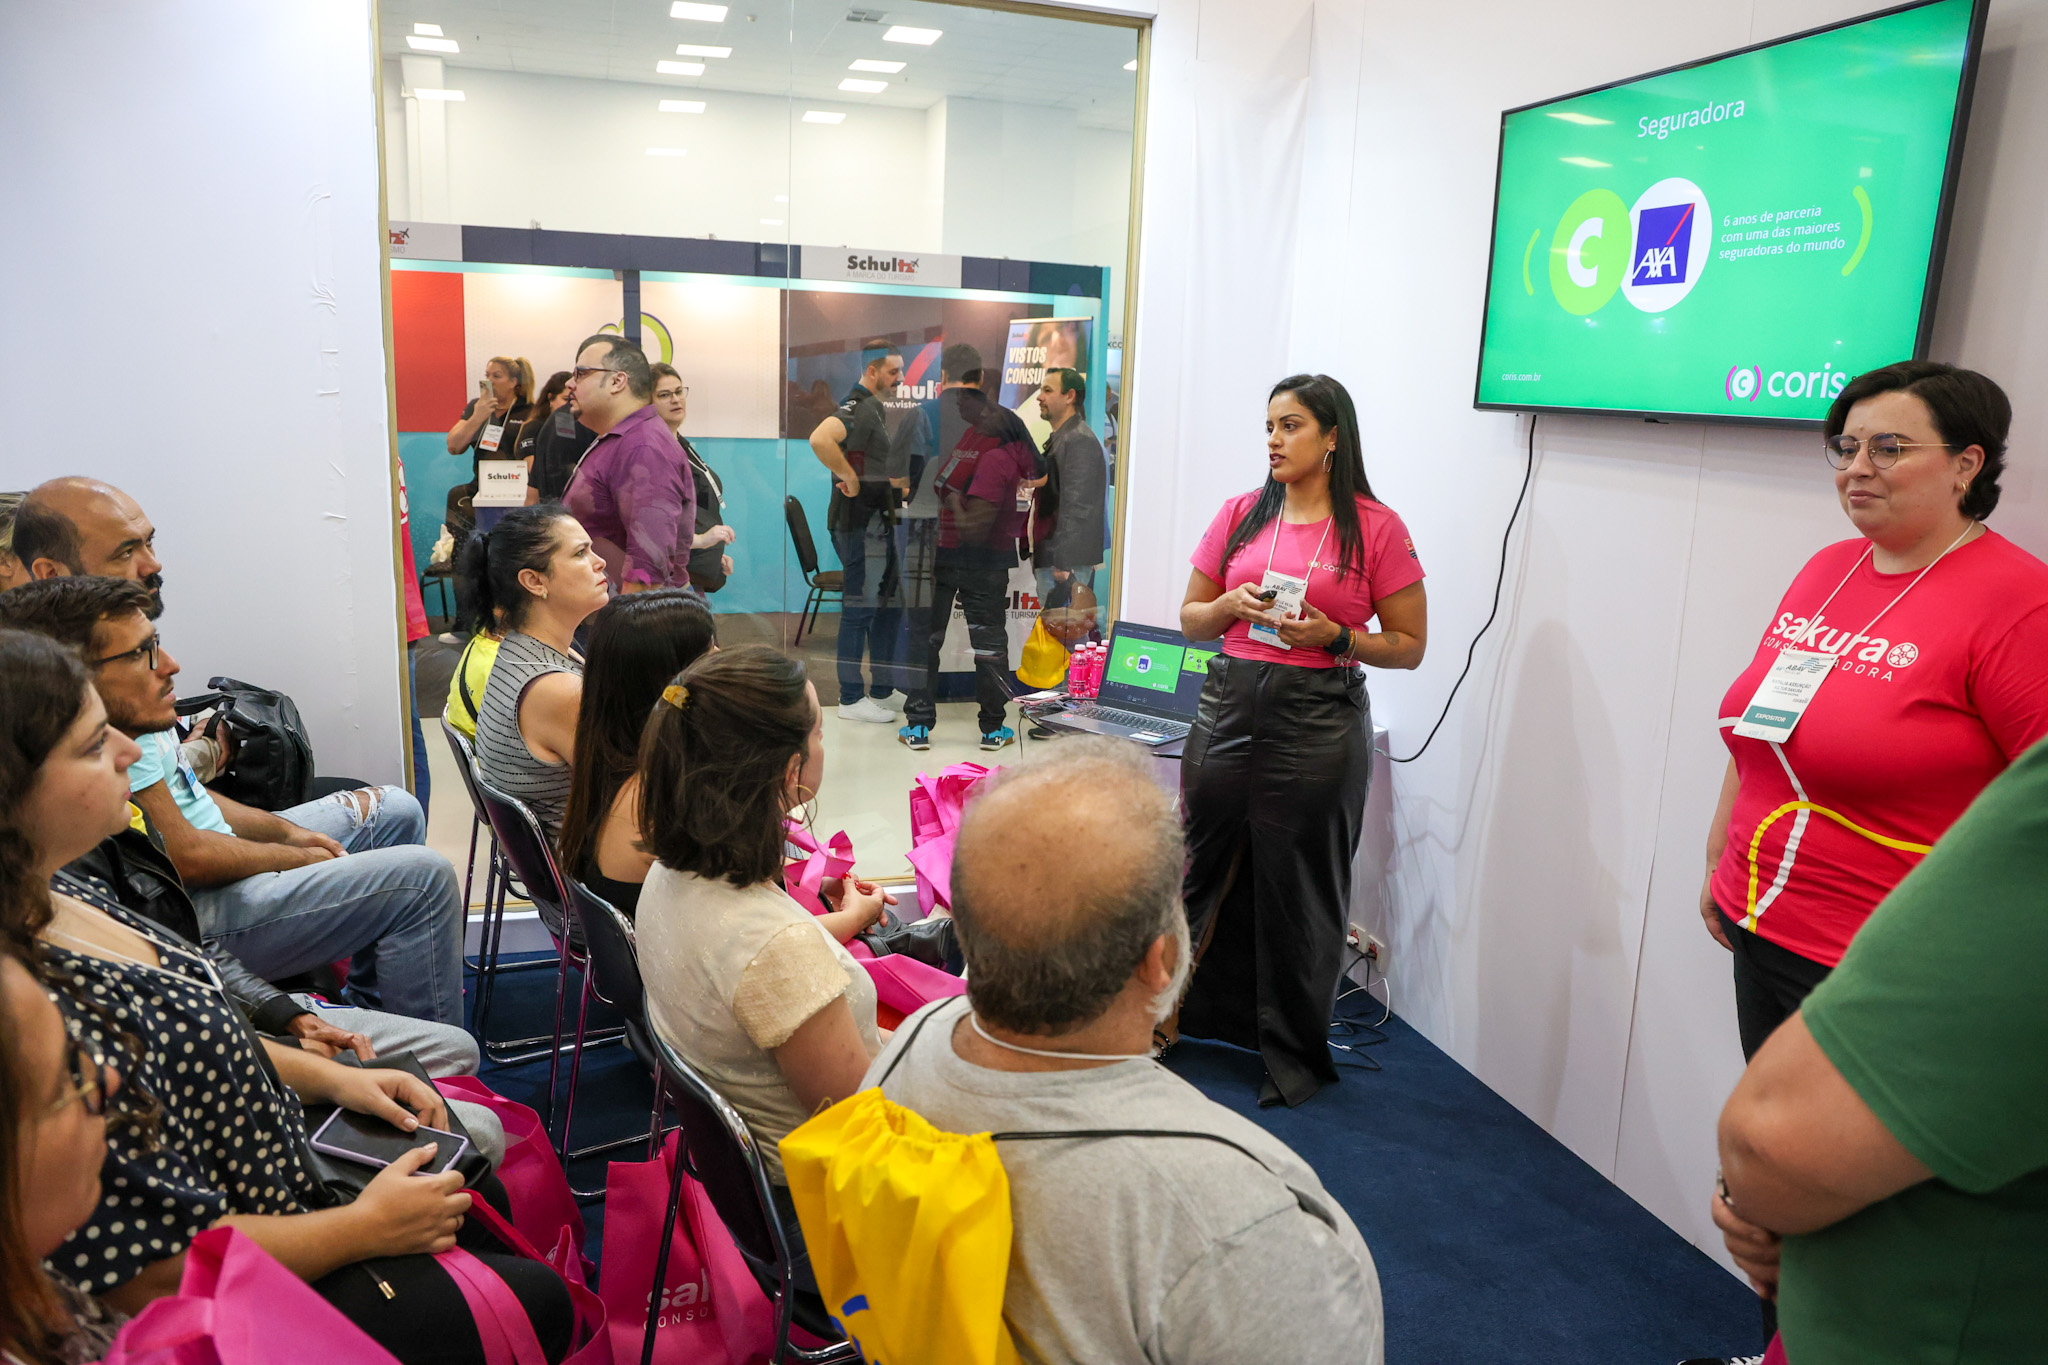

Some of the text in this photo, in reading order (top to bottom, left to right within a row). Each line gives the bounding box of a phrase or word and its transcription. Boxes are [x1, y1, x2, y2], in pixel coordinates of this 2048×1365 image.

[1637, 100, 1745, 140] Seguradora
[1723, 205, 1822, 227] 6 anos de parceria
[1721, 222, 1841, 243] com uma das maiores
[1719, 237, 1846, 261] seguradoras do mundo
[847, 255, 915, 273] Schultz
[1631, 246, 1677, 279] AXA
[1008, 346, 1048, 363] VISTOS
[1501, 371, 1542, 382] coris.com.br
[1767, 362, 1846, 400] coris
[1010, 611, 1040, 620] TURISM
[1772, 612, 1890, 664] sakura
[1785, 664, 1807, 673] ABAV
[1754, 712, 1787, 723] EXPOSITOR
